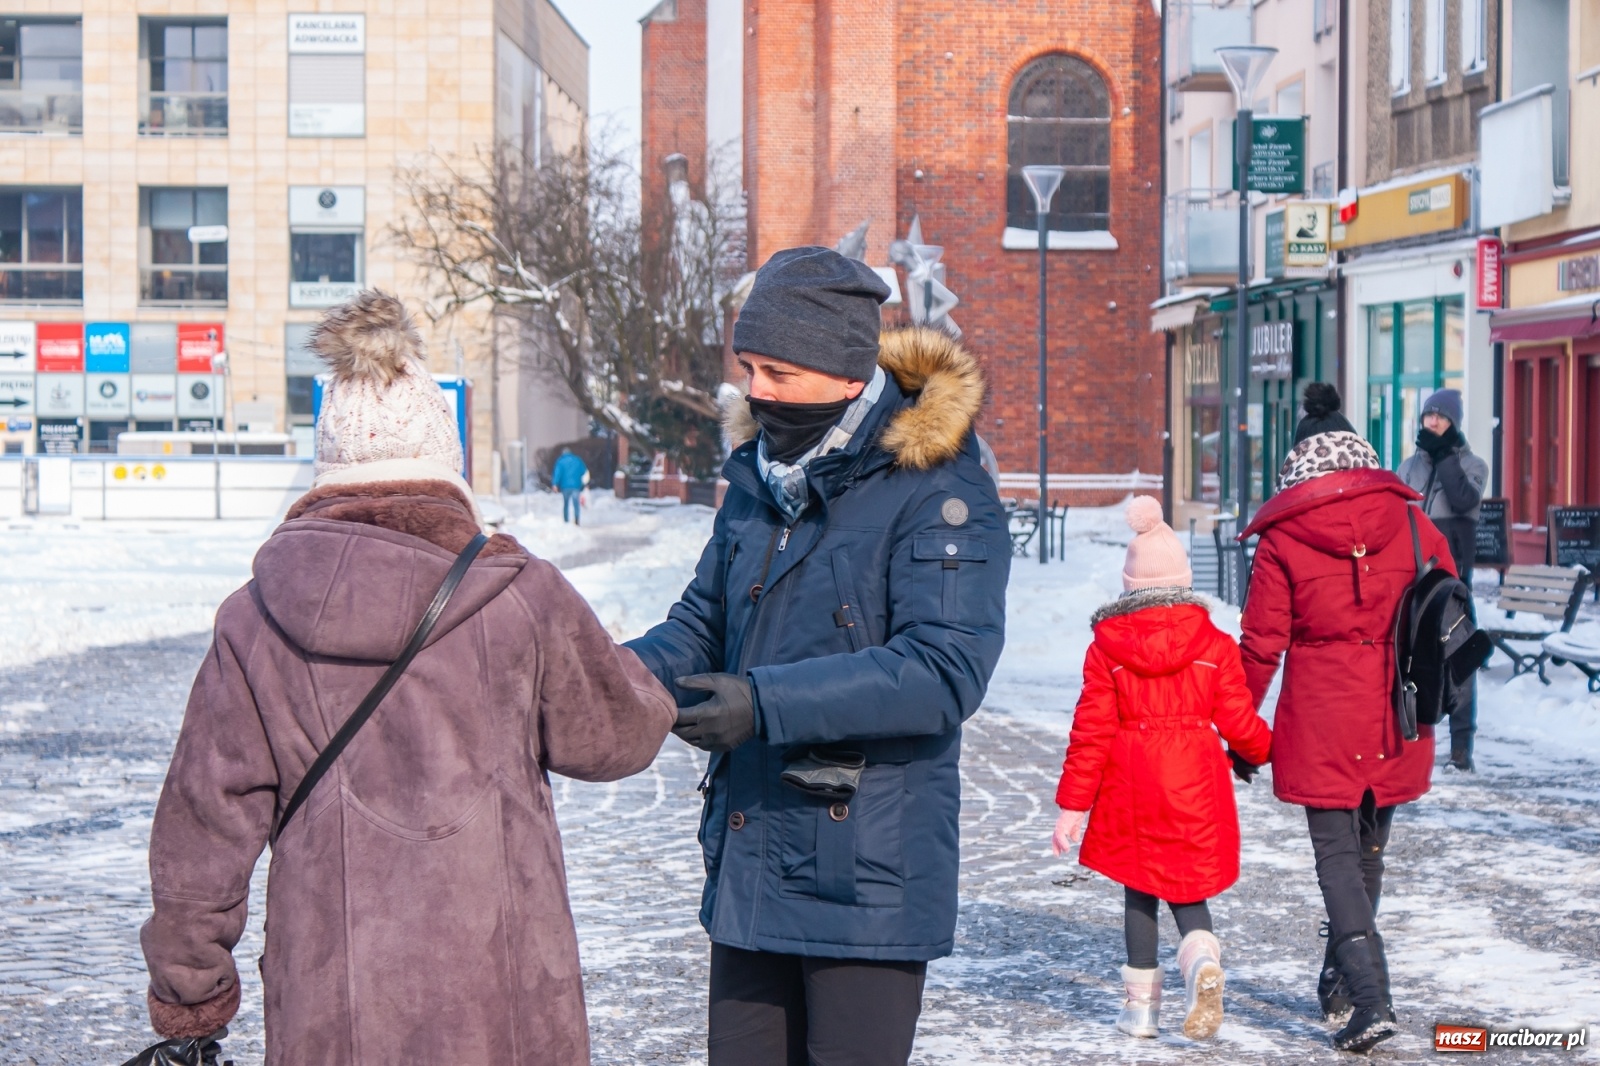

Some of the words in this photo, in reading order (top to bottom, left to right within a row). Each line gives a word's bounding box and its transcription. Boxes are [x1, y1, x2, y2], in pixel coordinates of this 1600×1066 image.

[294, 34, 359, 43] ADWOKACKA
[295, 21, 357, 29] KANCELARIA
[1482, 244, 1498, 302] ŻYWIEC
[1252, 322, 1293, 356] JUBILER
[1185, 335, 1219, 384] STELLA
